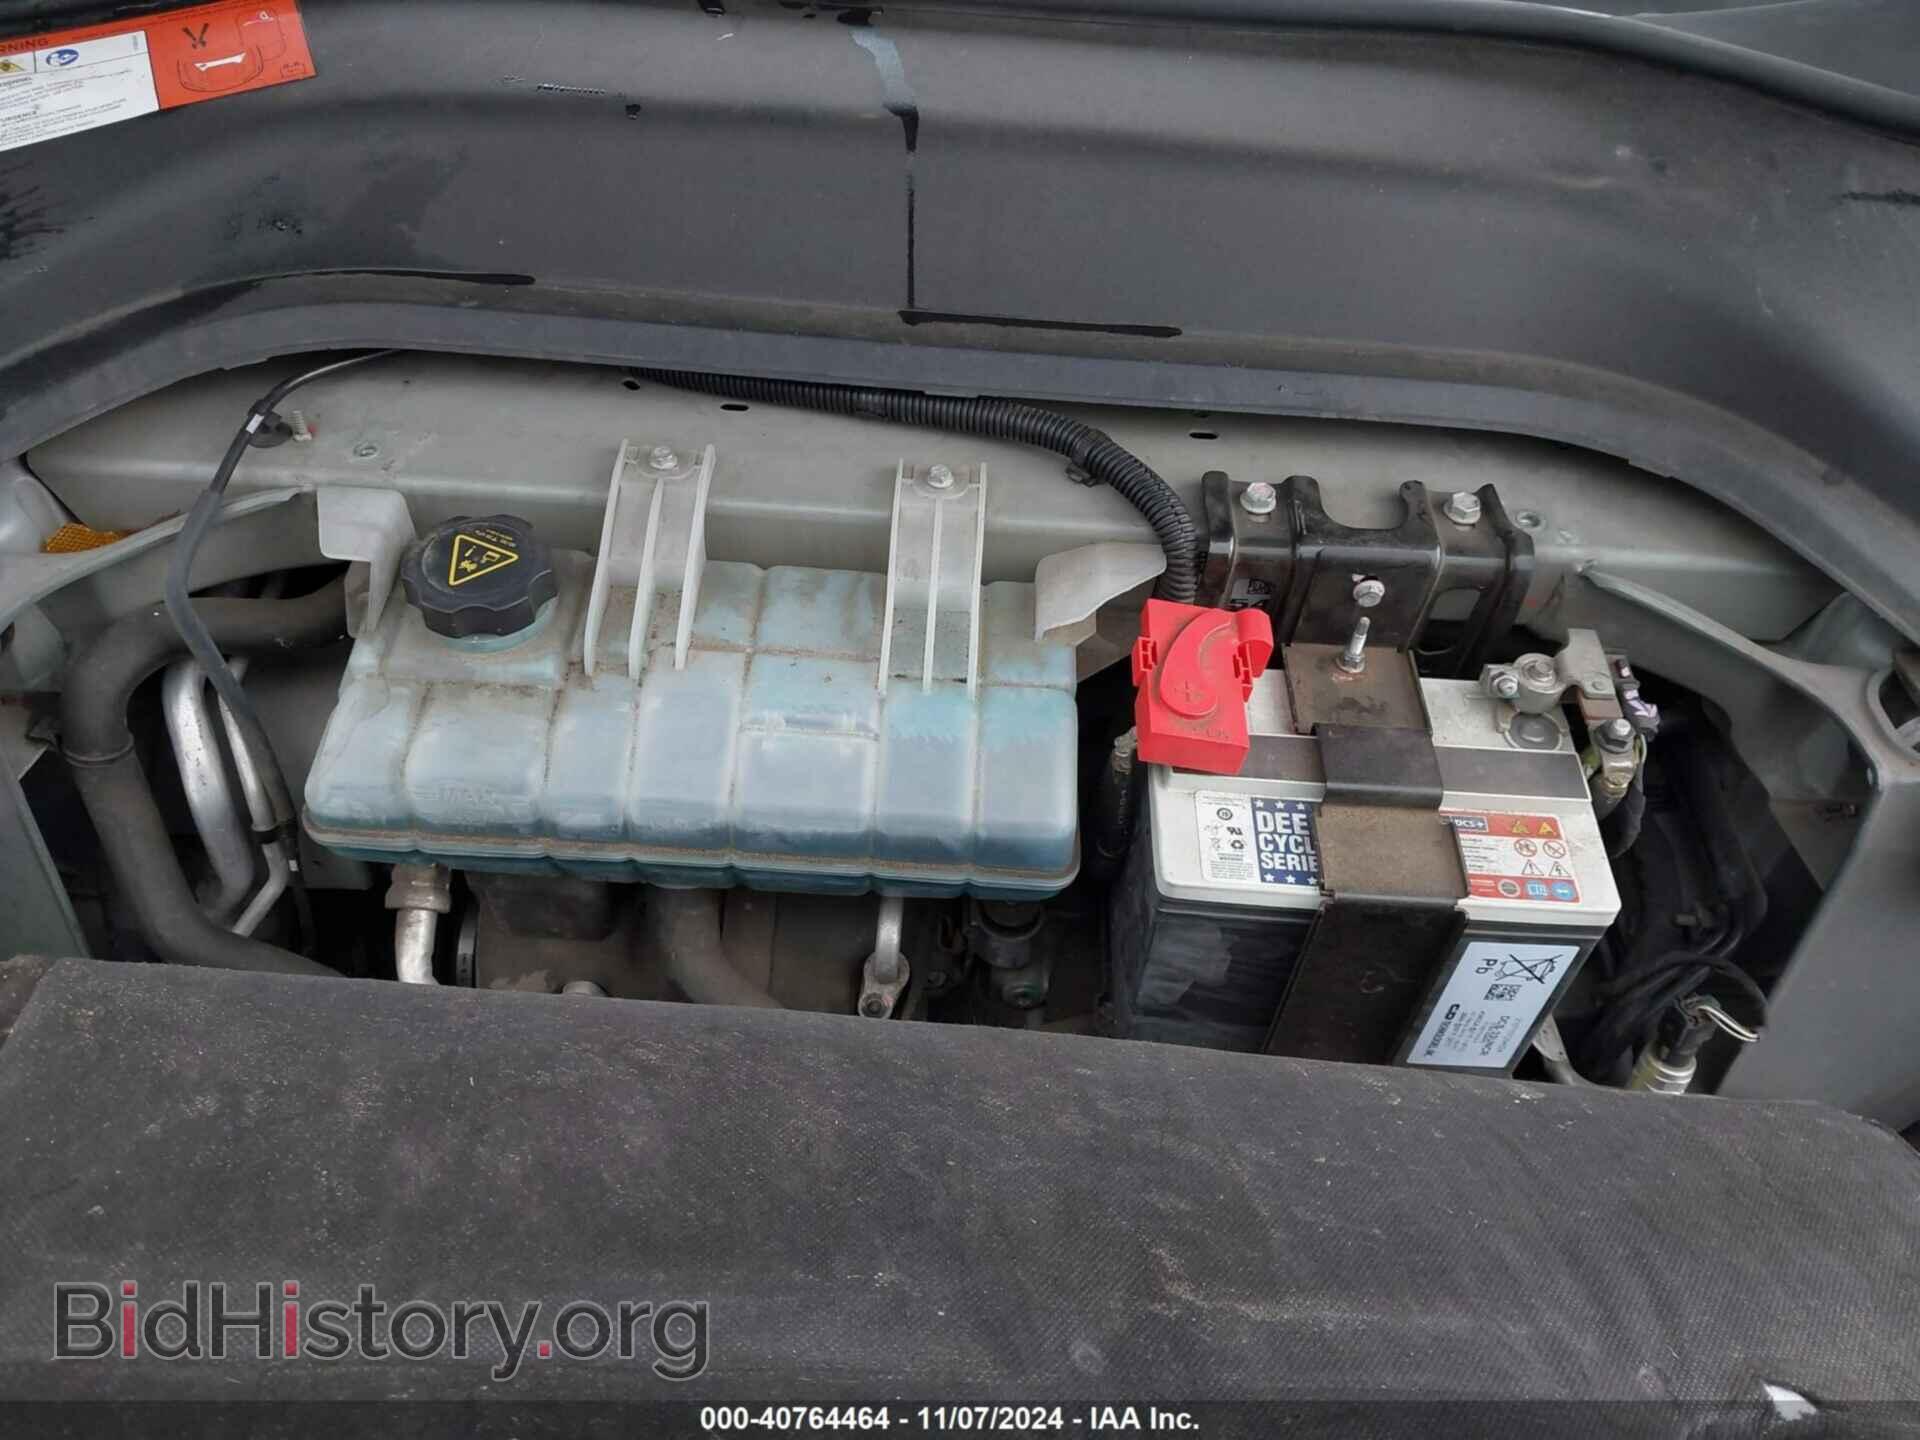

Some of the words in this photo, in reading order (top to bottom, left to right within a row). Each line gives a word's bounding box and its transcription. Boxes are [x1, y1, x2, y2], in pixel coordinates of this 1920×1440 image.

[1255, 809, 1310, 836] DEE
[1258, 833, 1317, 855] CYCL
[1260, 852, 1320, 873] SERIE
[1475, 958, 1498, 975] Pb
